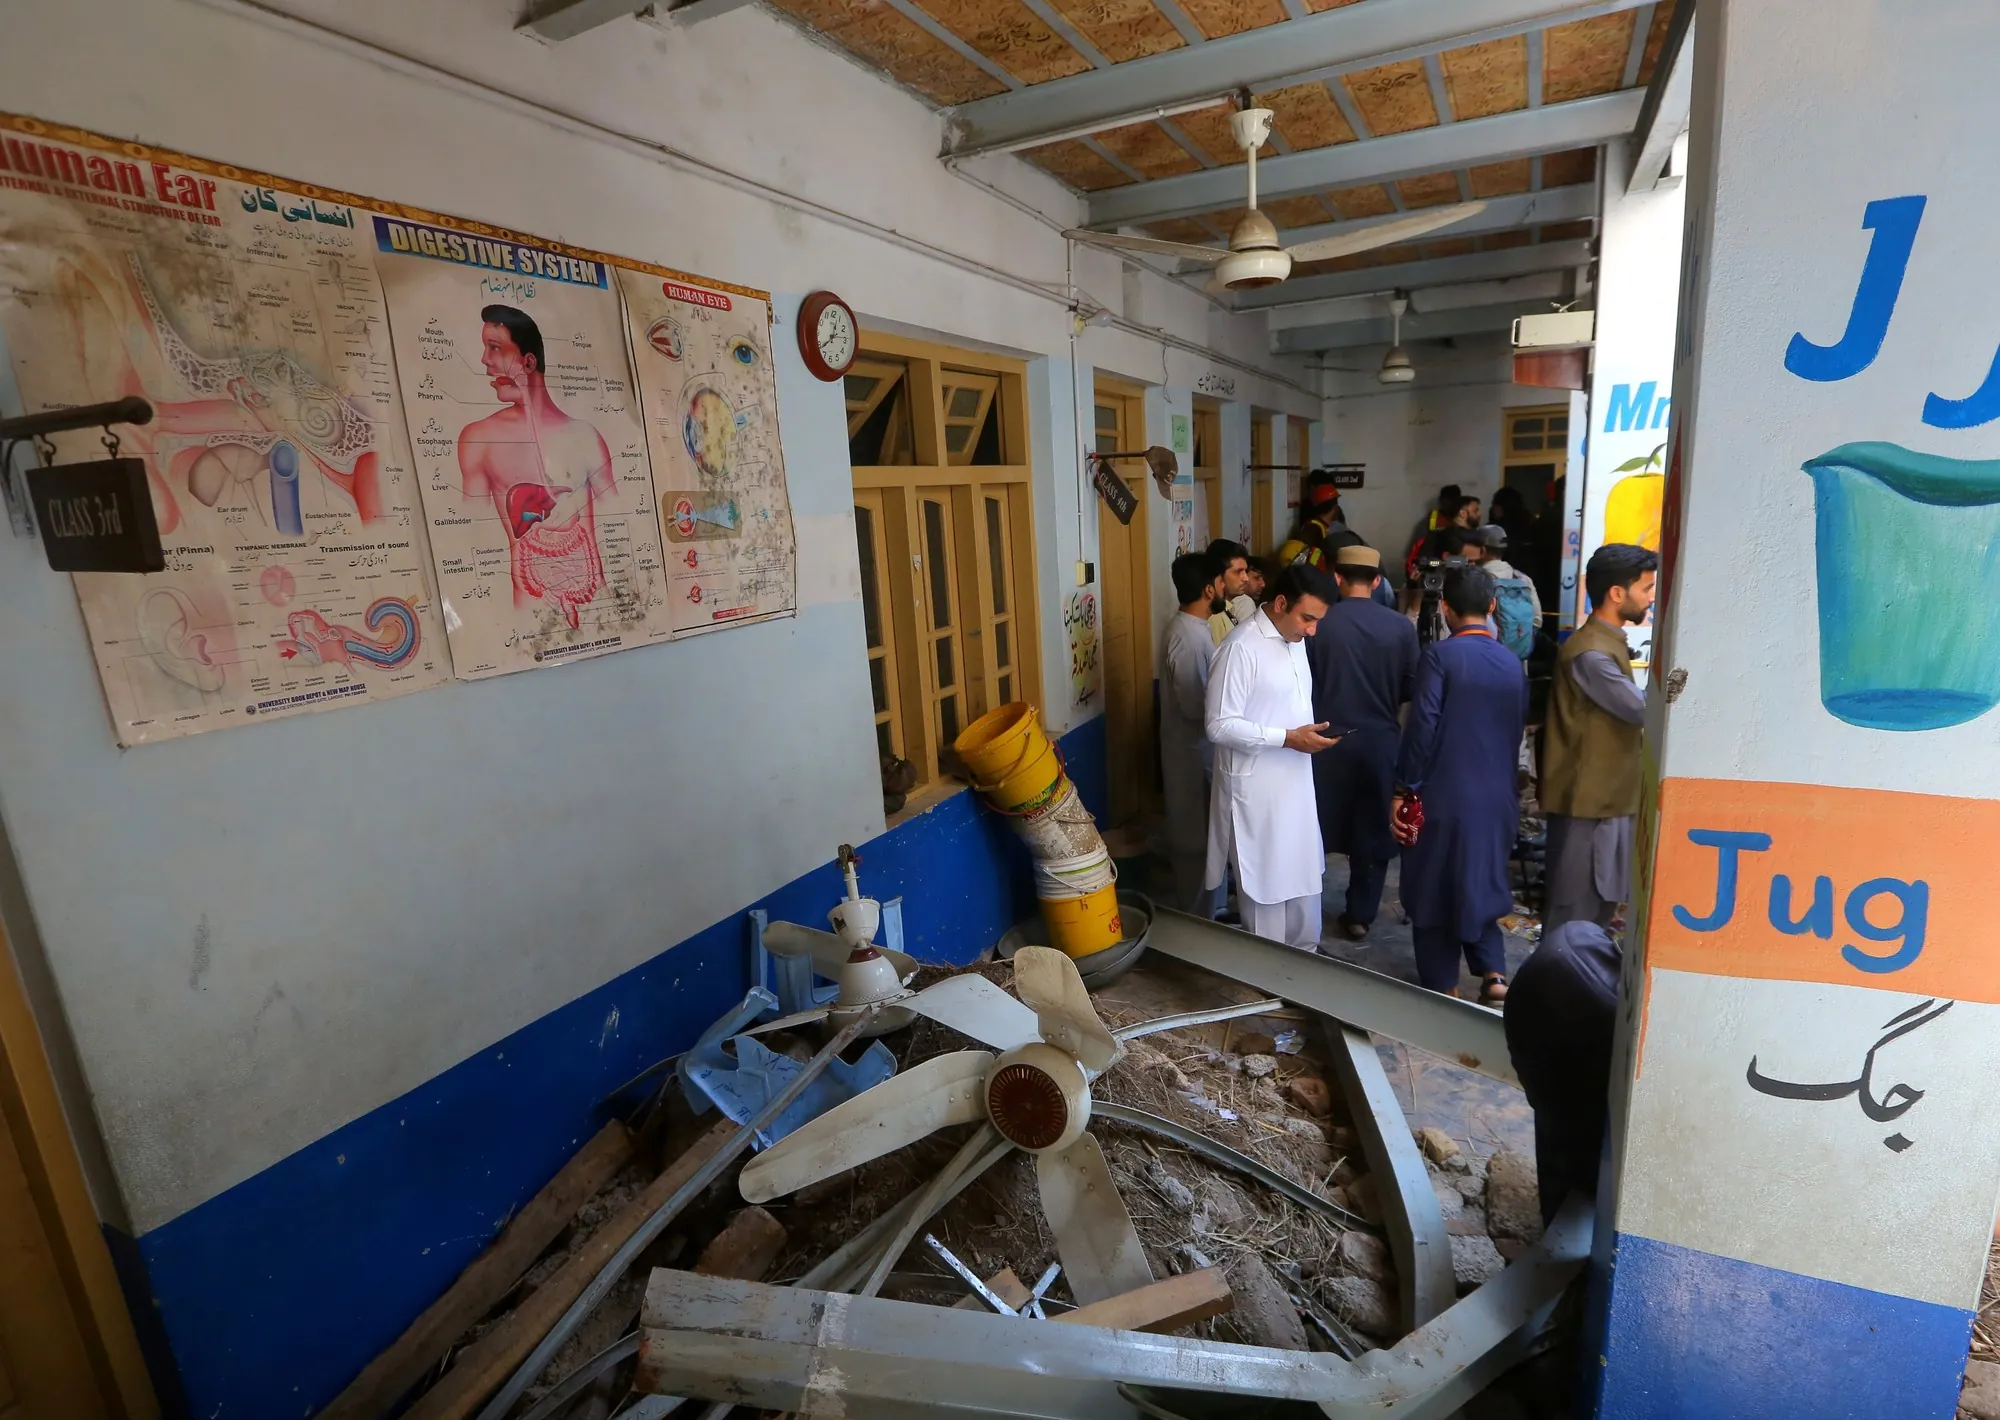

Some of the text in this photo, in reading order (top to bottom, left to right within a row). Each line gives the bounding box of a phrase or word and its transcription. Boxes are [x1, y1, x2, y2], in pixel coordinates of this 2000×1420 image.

[151, 163, 217, 211] Ear
[241, 186, 354, 229] انسانی کان
[122, 199, 186, 221] STRUCTURE
[188, 211, 201, 223] OF
[202, 213, 222, 228] EAR
[246, 248, 275, 259] Internal
[387, 222, 600, 285] DIGESTIVE SYSTEM
[1784, 195, 1927, 382] J
[667, 286, 728, 309] HUMAN EYE
[831, 310, 837, 319] 12
[424, 327, 444, 336] Mouth
[841, 324, 846, 333] 2
[417, 335, 454, 347] (oral cavity)
[572, 340, 592, 349] Tongue
[843, 336, 847, 345] 3
[822, 351, 827, 359] 7
[828, 355, 833, 363] 6
[835, 353, 840, 362] 5
[560, 374, 584, 382] Sublingual
[417, 392, 443, 401] Pharynx
[417, 437, 453, 446] Esophagus
[1099, 472, 1128, 513] CLASS 4th
[232, 505, 248, 513] drum
[50, 493, 123, 538] CLASS 3rd
[305, 512, 337, 520] Eustachian
[434, 518, 472, 526] Gallbladder
[176, 545, 215, 556] (Pinna)
[271, 542, 307, 550] MEMBRANE
[319, 544, 375, 553] Transmission
[387, 541, 410, 549] sound
[442, 558, 462, 567] Small
[478, 559, 501, 567] Jejunum
[543, 646, 568, 656] UNIVERSITY
[258, 696, 291, 709] UNIVERSITY
[291, 694, 305, 703] BOOK
[306, 692, 321, 701] DEPOT
[339, 686, 349, 694] MAP
[350, 683, 366, 692] HOUSE
[1672, 827, 1931, 974] Jug
[1746, 998, 1955, 1153] جگ
